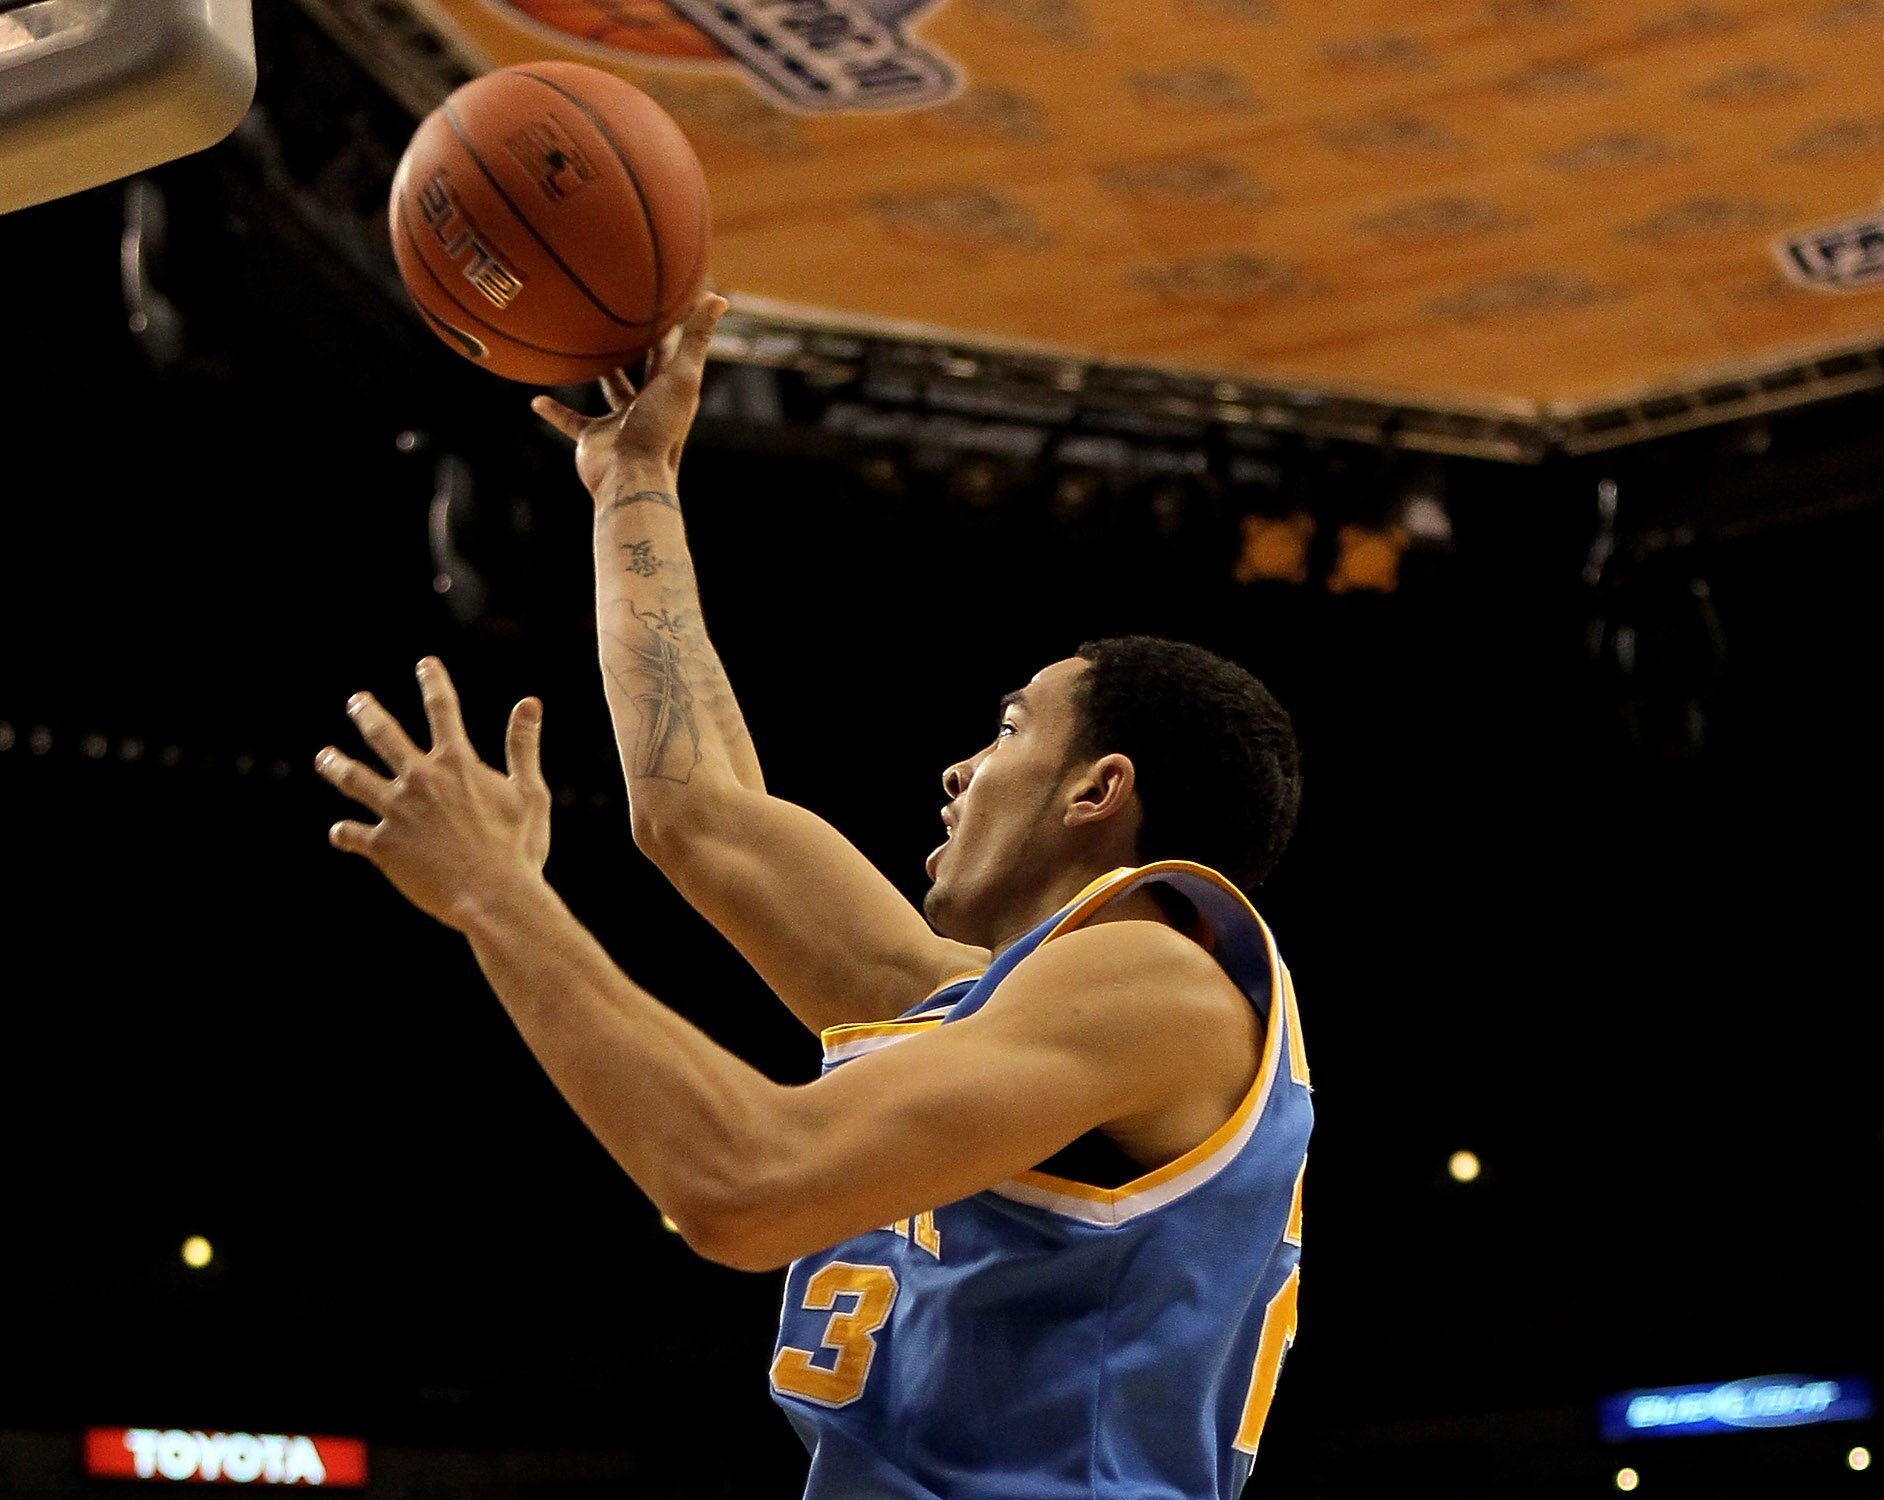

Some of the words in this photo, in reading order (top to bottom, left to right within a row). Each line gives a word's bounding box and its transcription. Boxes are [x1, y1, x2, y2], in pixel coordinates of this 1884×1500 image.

[418, 168, 524, 310] ELITE
[769, 1260, 900, 1409] 3
[122, 1428, 327, 1486] TOYOTA
